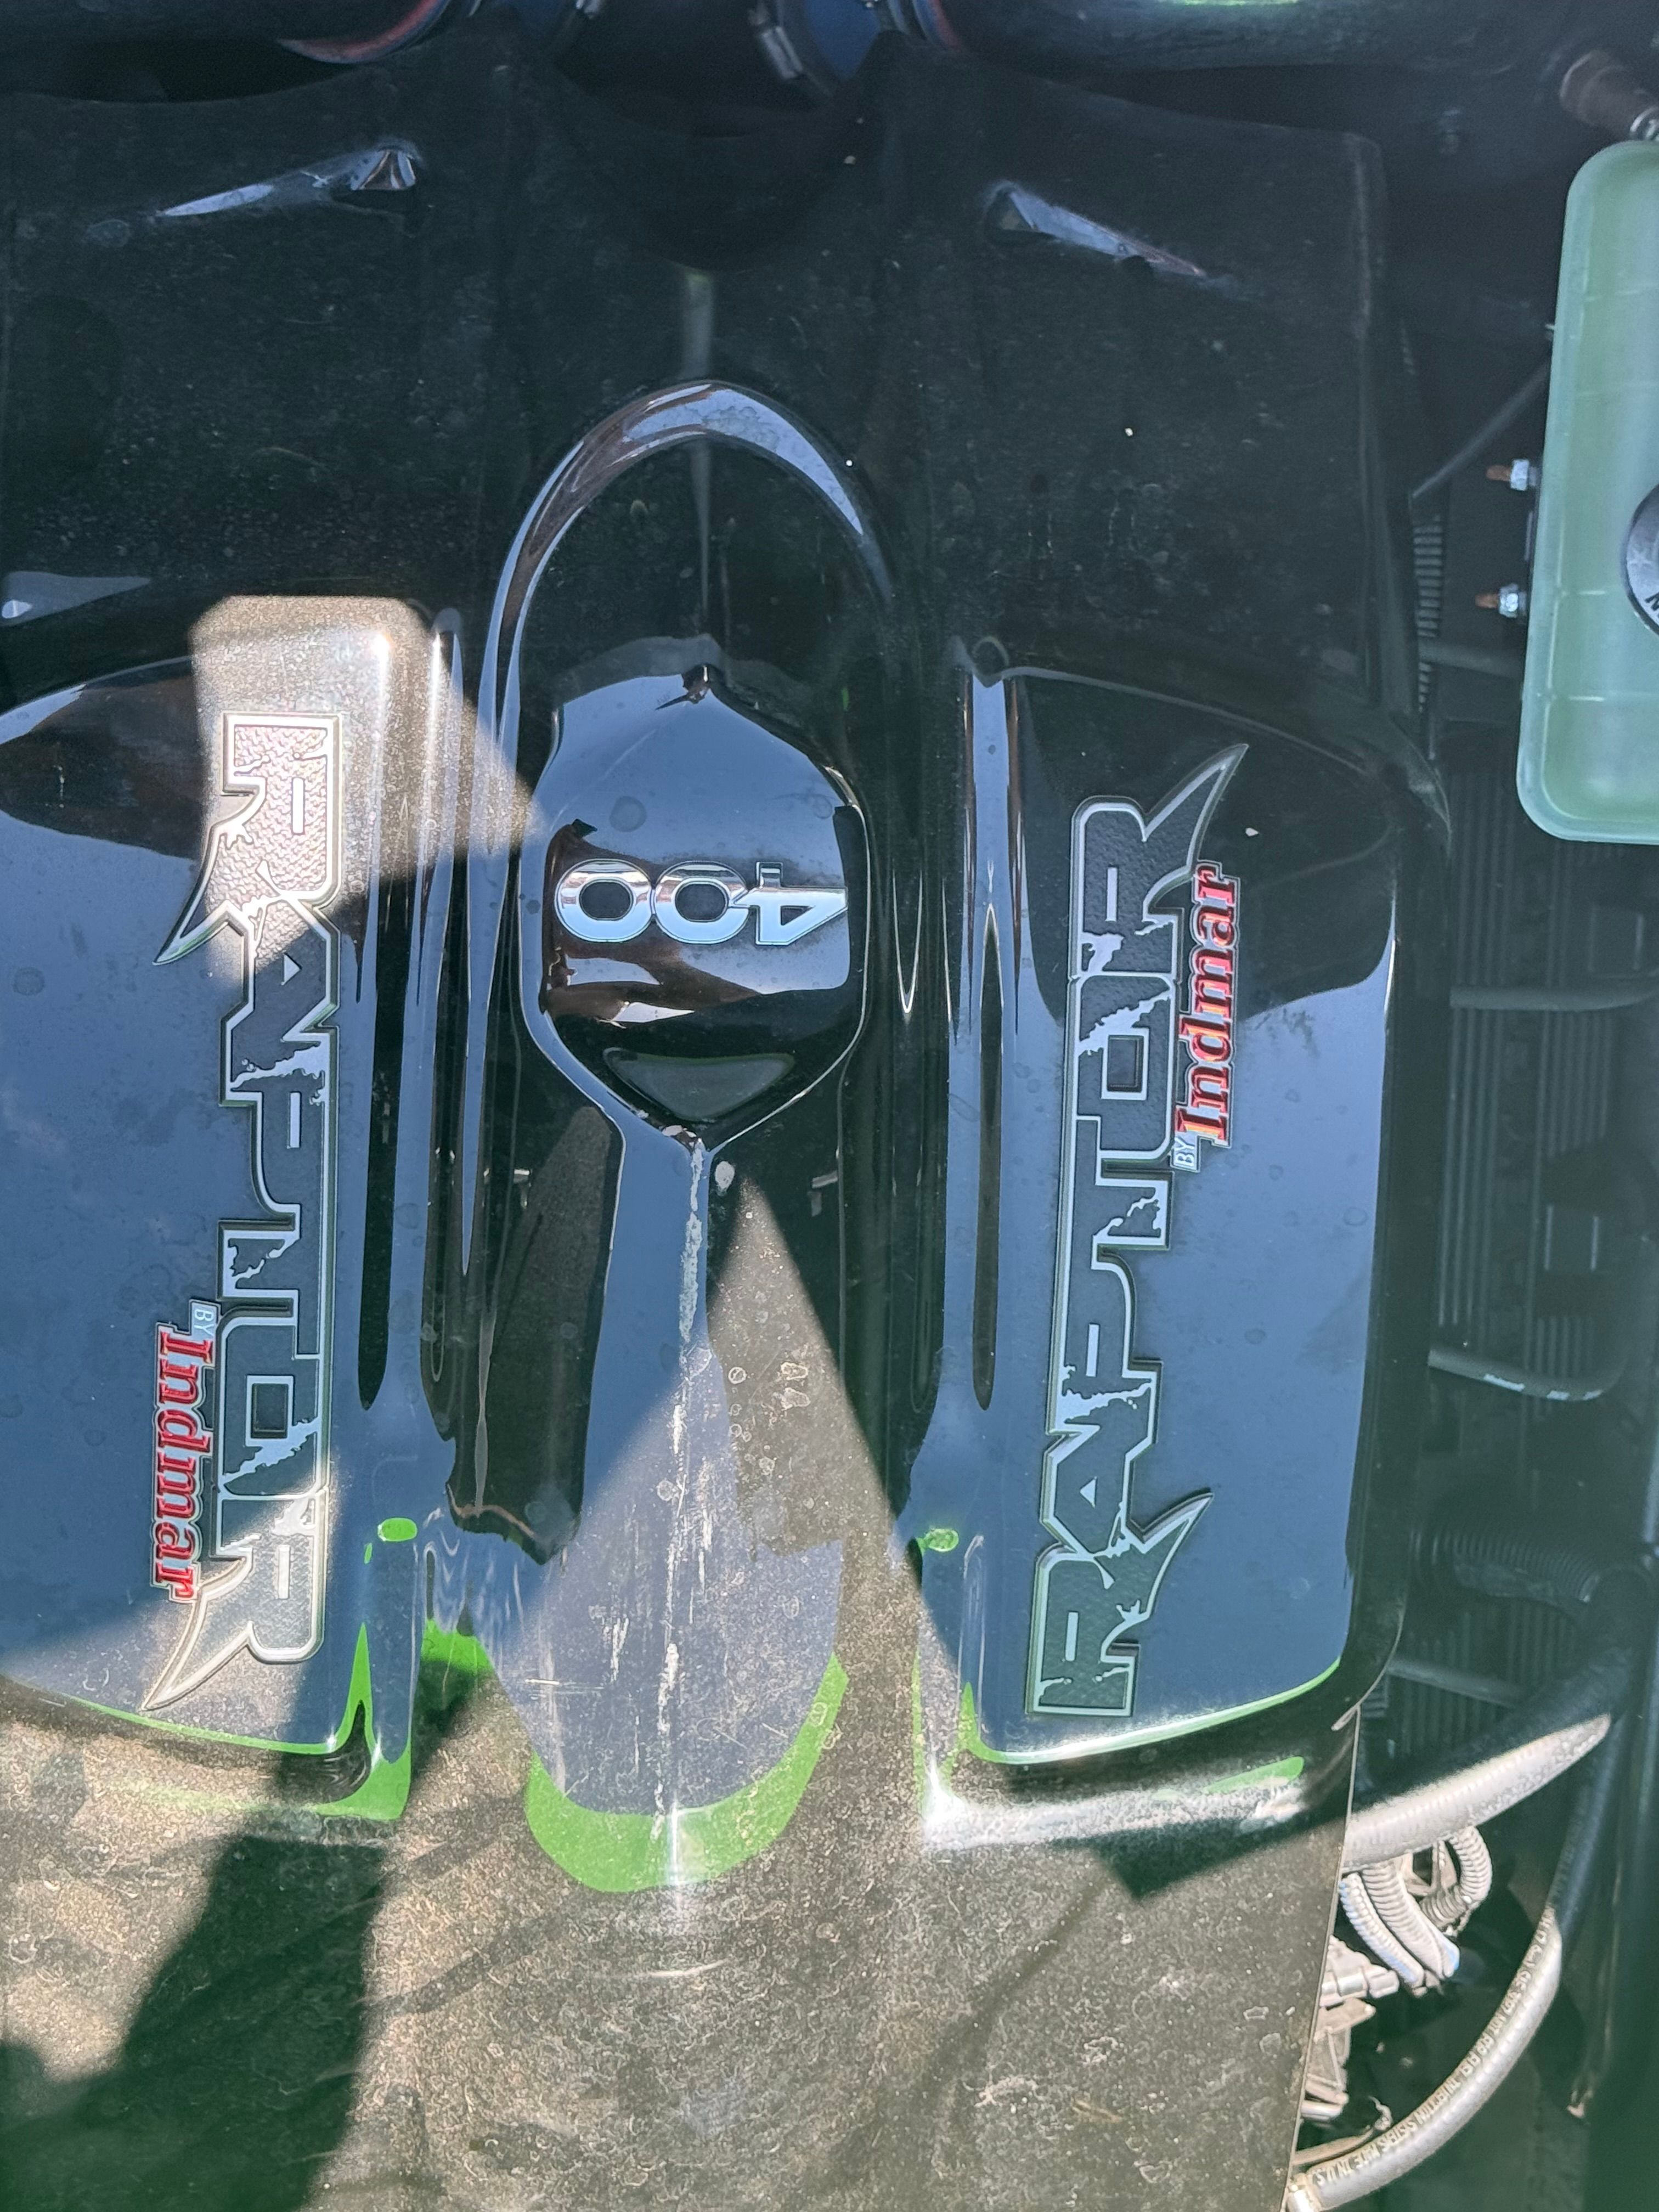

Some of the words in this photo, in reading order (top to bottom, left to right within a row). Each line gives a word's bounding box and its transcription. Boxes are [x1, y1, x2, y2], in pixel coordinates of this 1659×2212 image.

[555, 858, 848, 946] 400
[1175, 864, 1238, 1144] Indmar
[142, 712, 339, 1711] RAPTOR
[1024, 743, 1249, 1718] RAPTOR
[1173, 1136, 1197, 1167] BY
[193, 1307, 215, 1338] BY
[156, 1330, 214, 1600] Indmar
